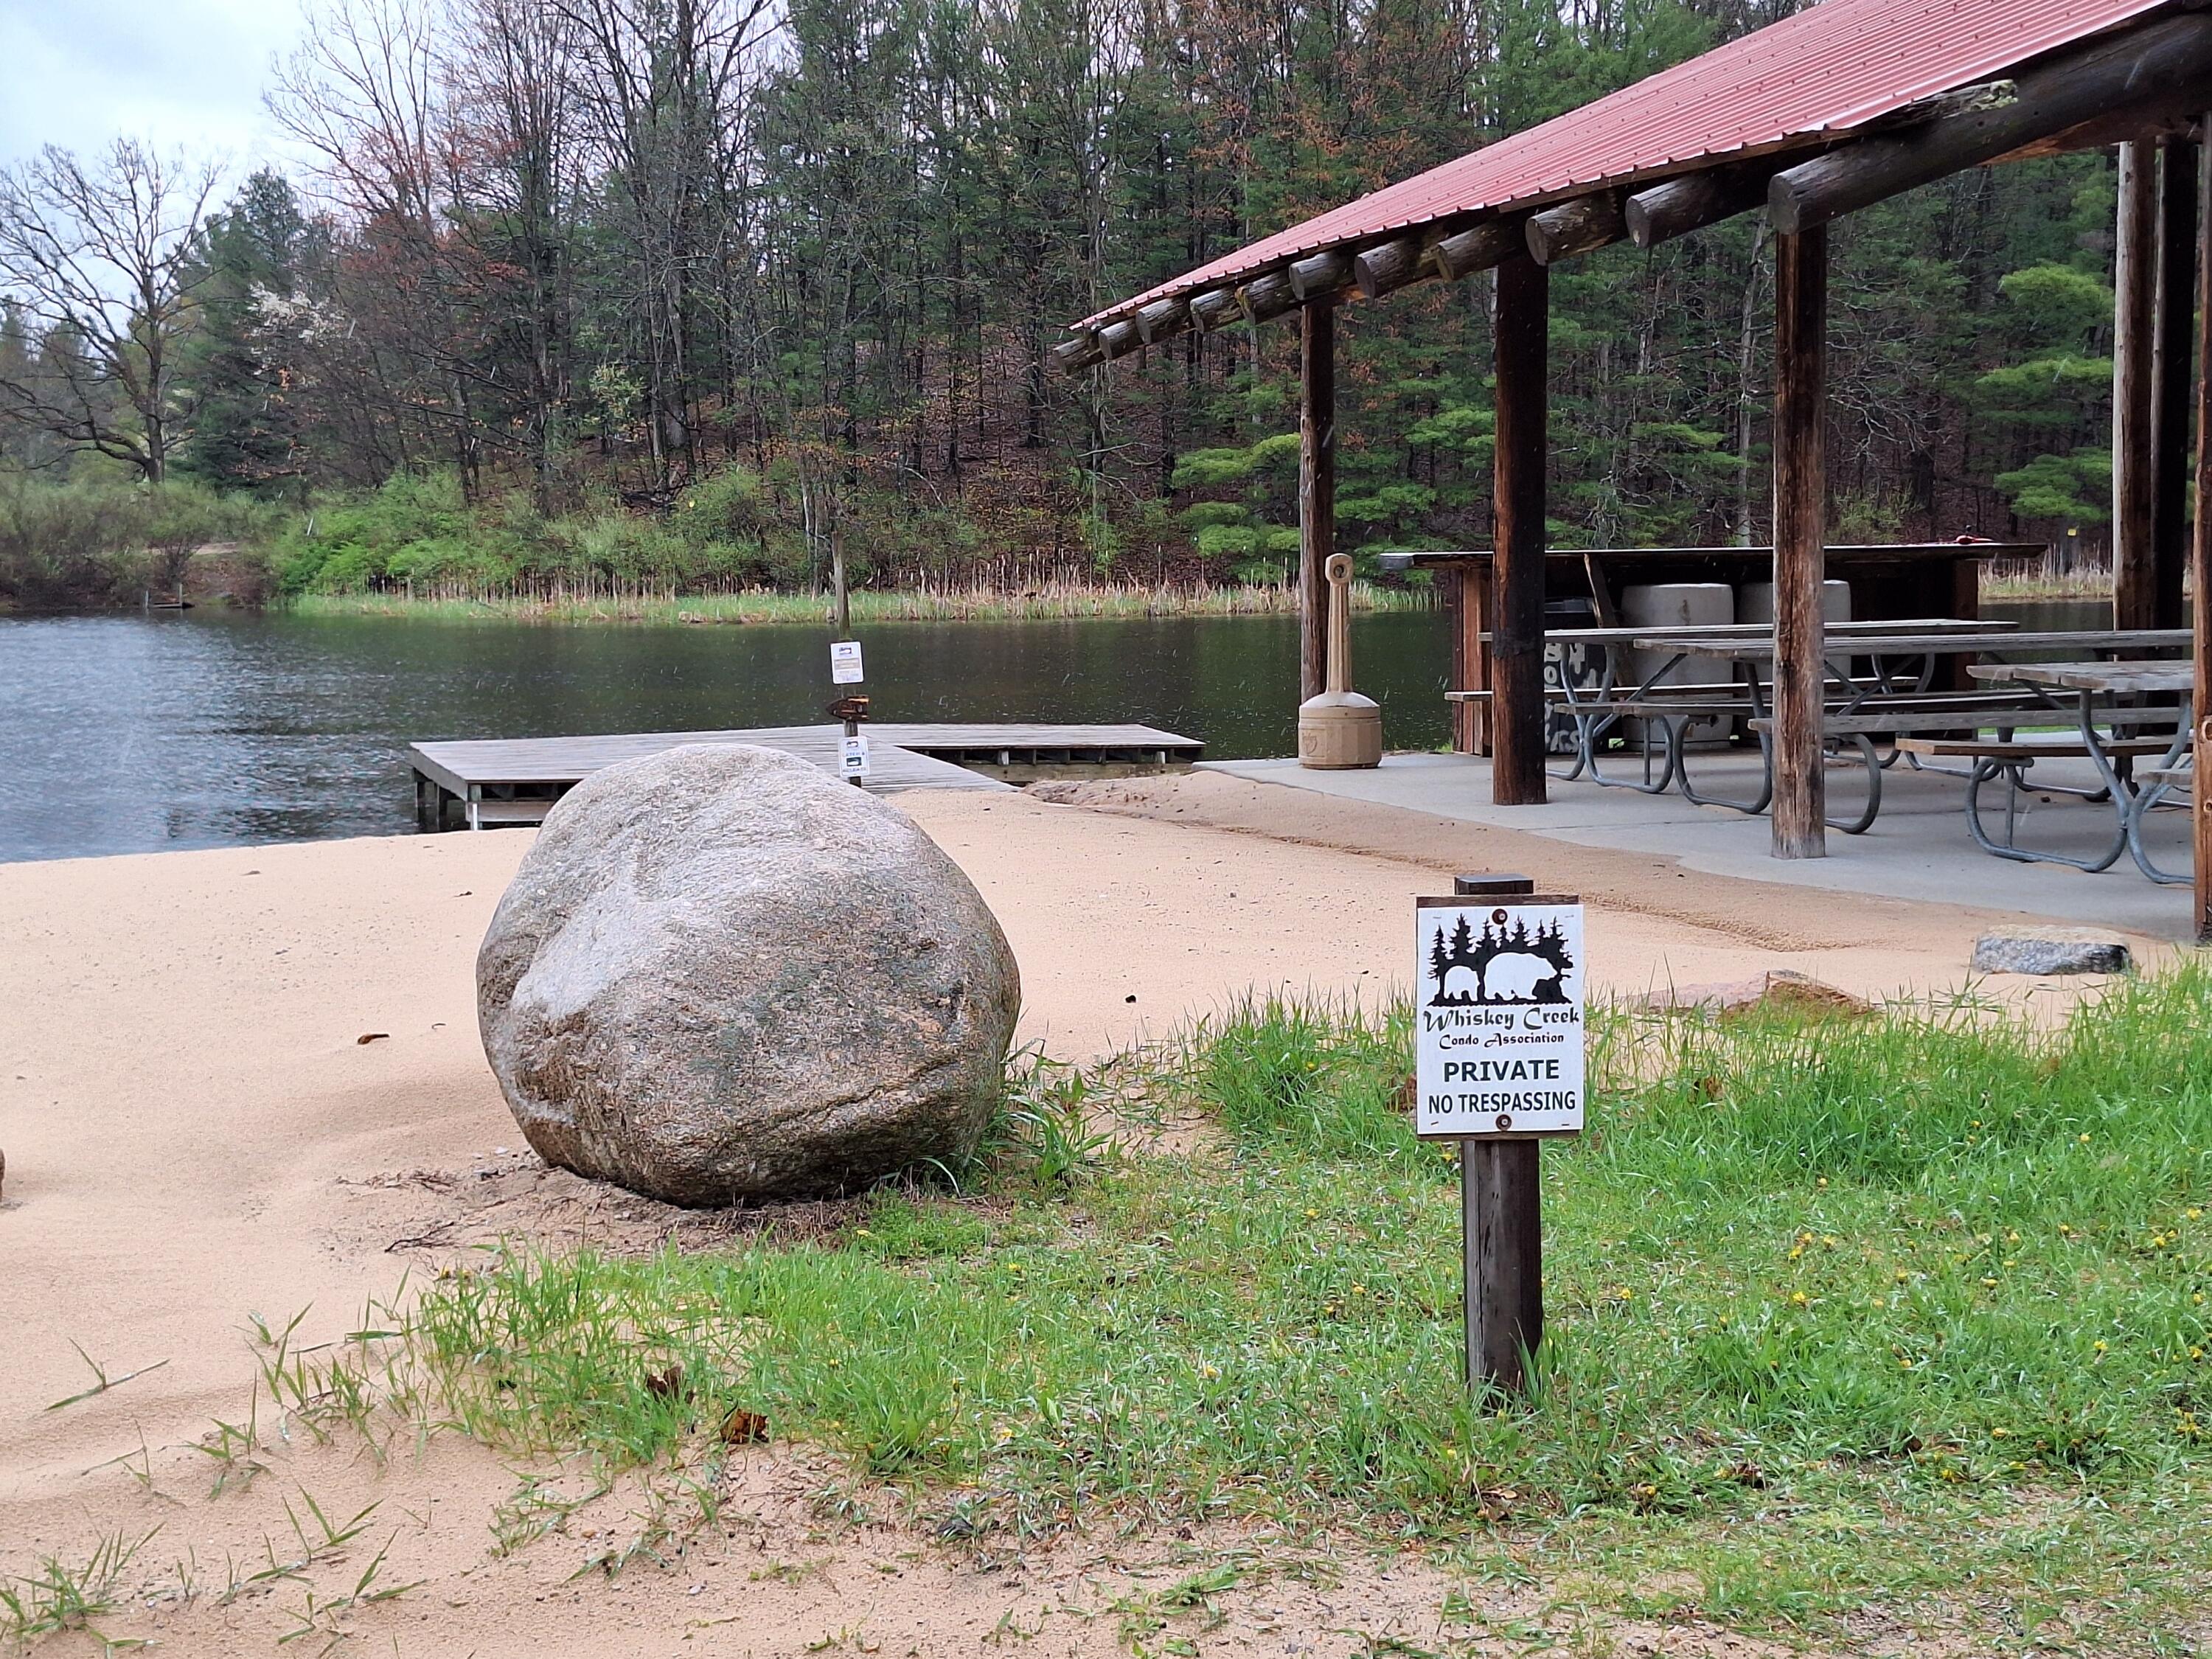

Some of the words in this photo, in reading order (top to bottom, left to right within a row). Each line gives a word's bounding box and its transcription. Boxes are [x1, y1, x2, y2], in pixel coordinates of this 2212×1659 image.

[1423, 1009, 1514, 1032] Whiskey
[1523, 1007, 1579, 1029] Creek
[1439, 1034, 1479, 1049] Condo
[1484, 1033, 1564, 1048] Association
[1444, 1059, 1559, 1082] PRIVATE
[1428, 1095, 1453, 1114] NO
[1458, 1091, 1576, 1113] TRESPASSING
